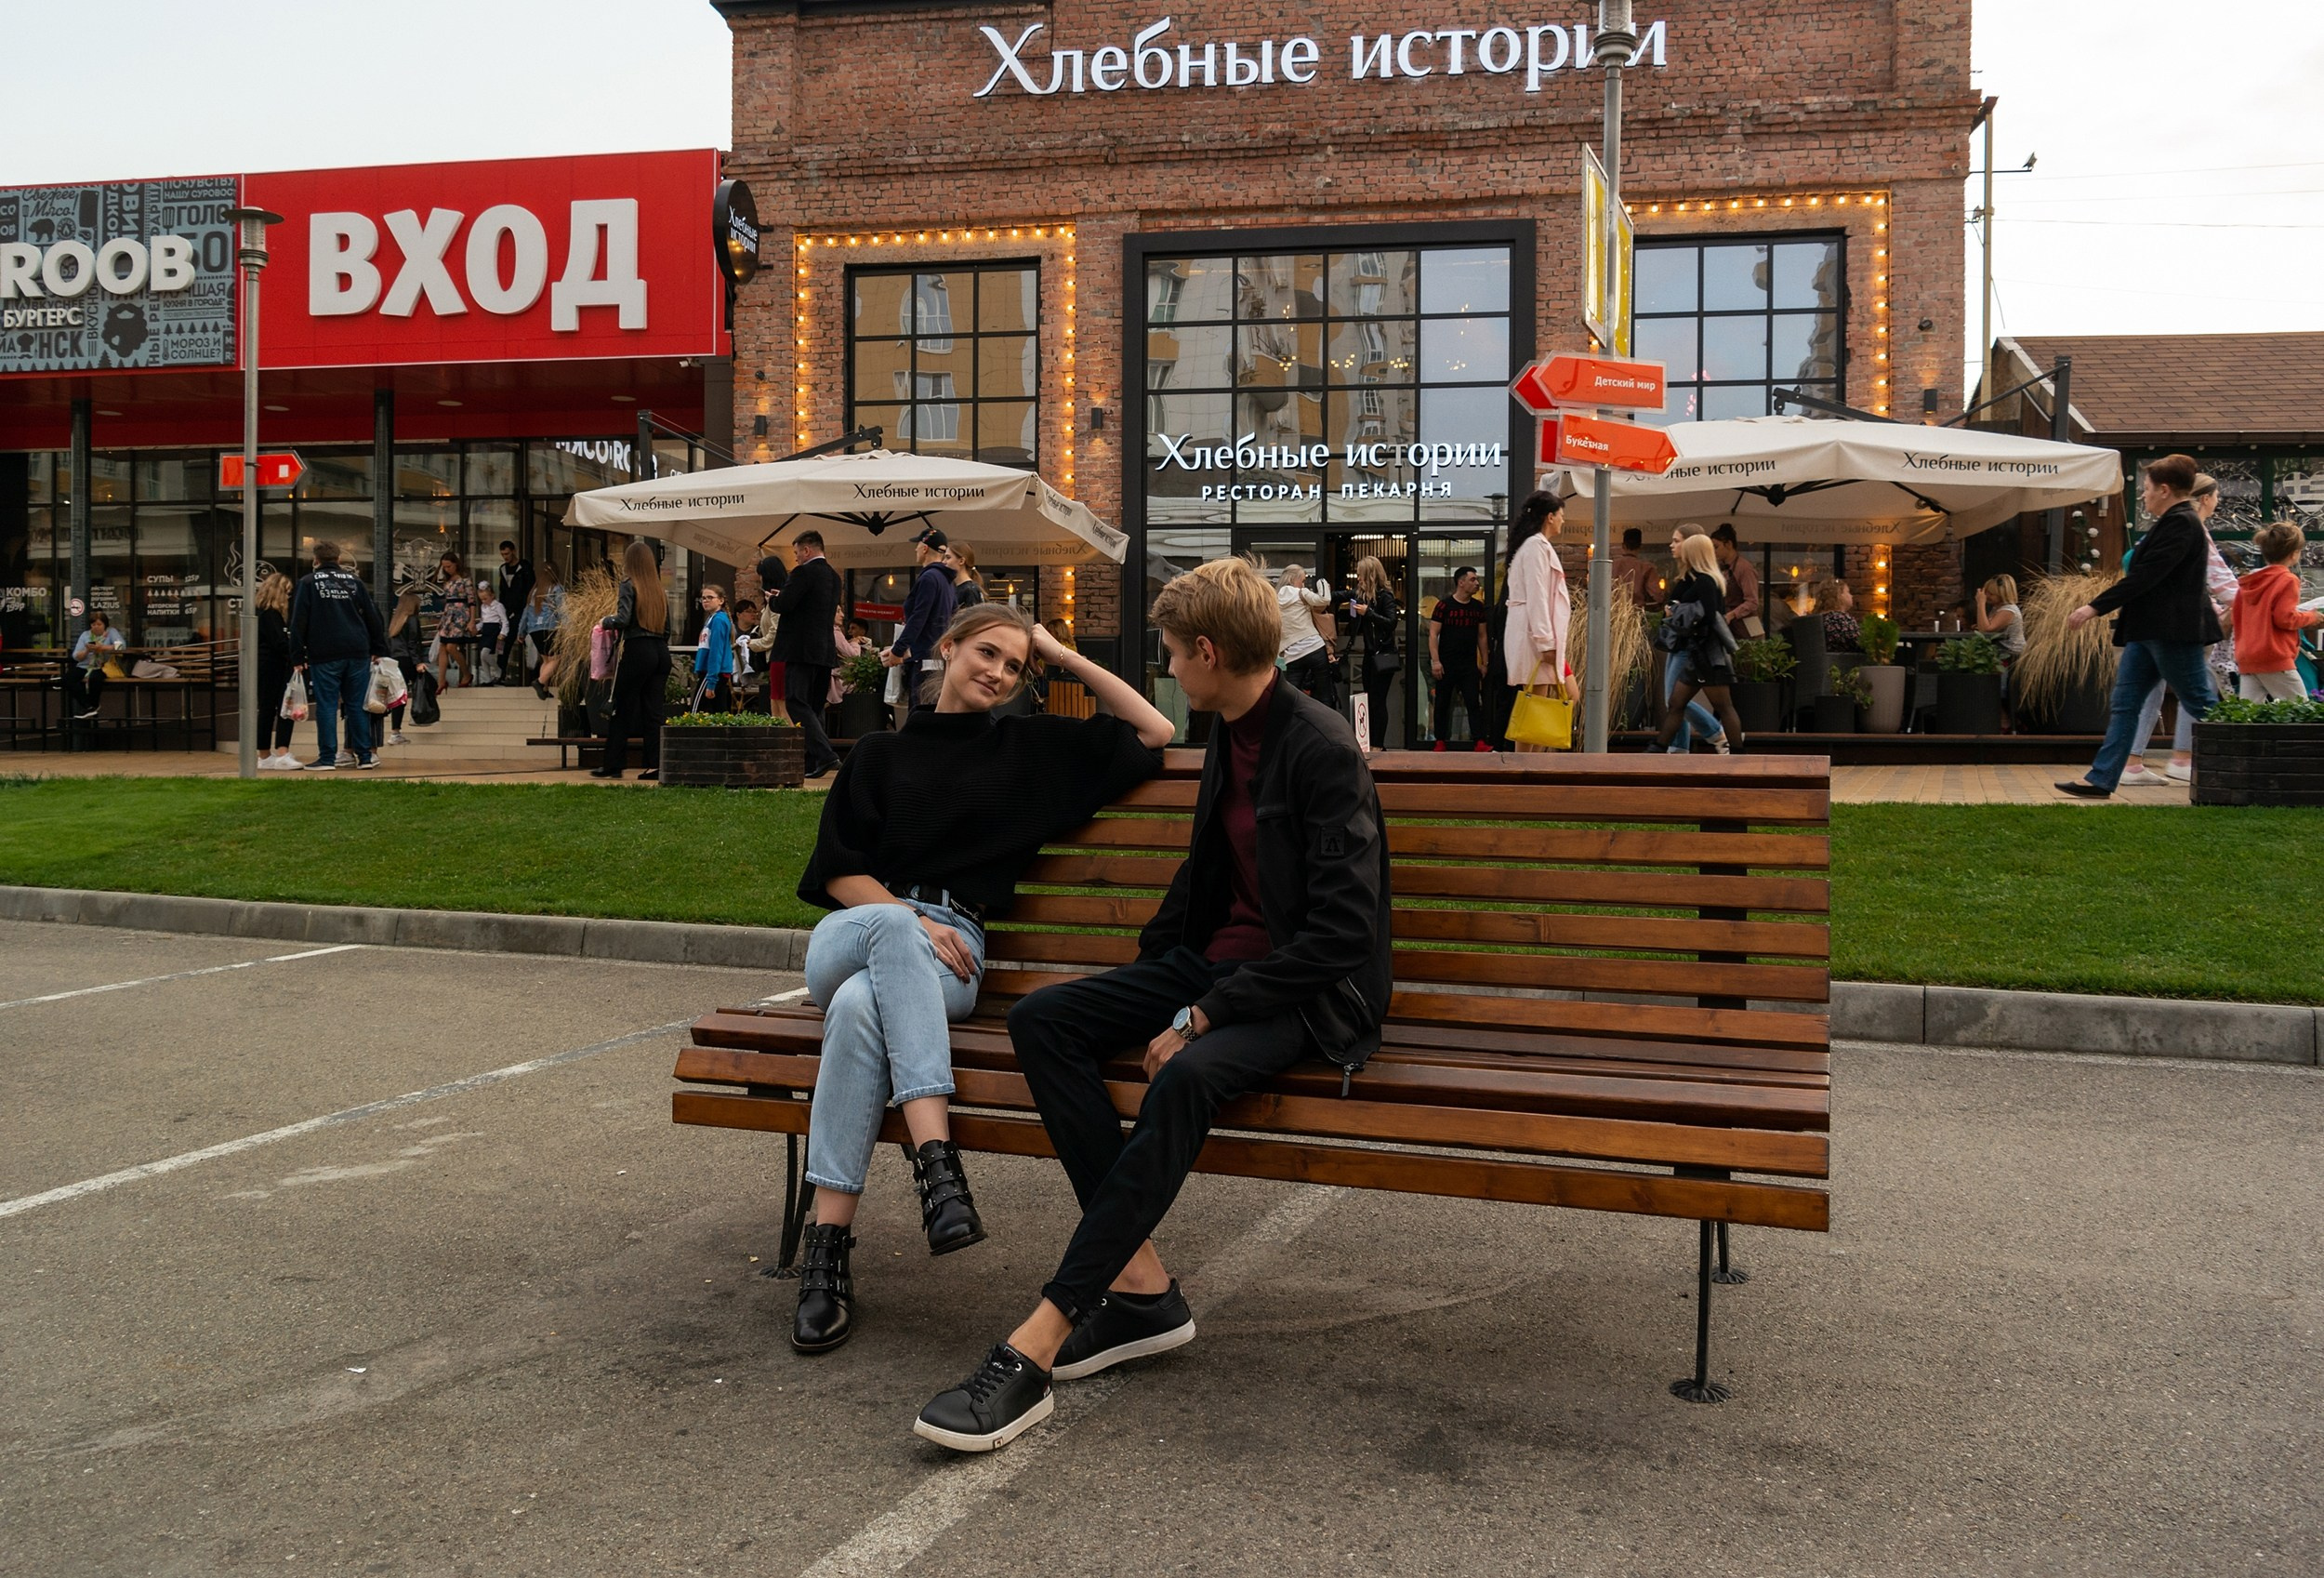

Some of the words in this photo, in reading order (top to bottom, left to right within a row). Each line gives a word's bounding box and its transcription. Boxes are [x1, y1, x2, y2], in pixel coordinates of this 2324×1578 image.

[972, 16, 1320, 98] Хлебные
[310, 198, 648, 331] ВХОД
[4, 307, 84, 328] БУРГЕРС
[171, 338, 210, 349] МОРОЗ
[213, 337, 221, 347] И
[171, 348, 222, 360] СОЛНЦЕ?
[1594, 376, 1635, 389] Детский
[1637, 381, 1656, 392] мир
[1565, 434, 1609, 452] Букетная
[1155, 431, 1330, 471] Хлебные
[1346, 442, 1501, 478] истории
[1708, 460, 1776, 478] истории
[1903, 452, 1981, 471] Хлебные
[1987, 461, 2059, 477] истории
[853, 483, 919, 499] Хлебные
[925, 487, 985, 501] истории
[1202, 484, 1322, 501] РЕСТОРАН
[1341, 482, 1452, 499] ПЕКАРНЯ
[619, 496, 683, 511] Хлебные
[688, 494, 745, 509] истории
[147, 575, 175, 583] СУПЫ
[6, 587, 47, 597] КОМБО
